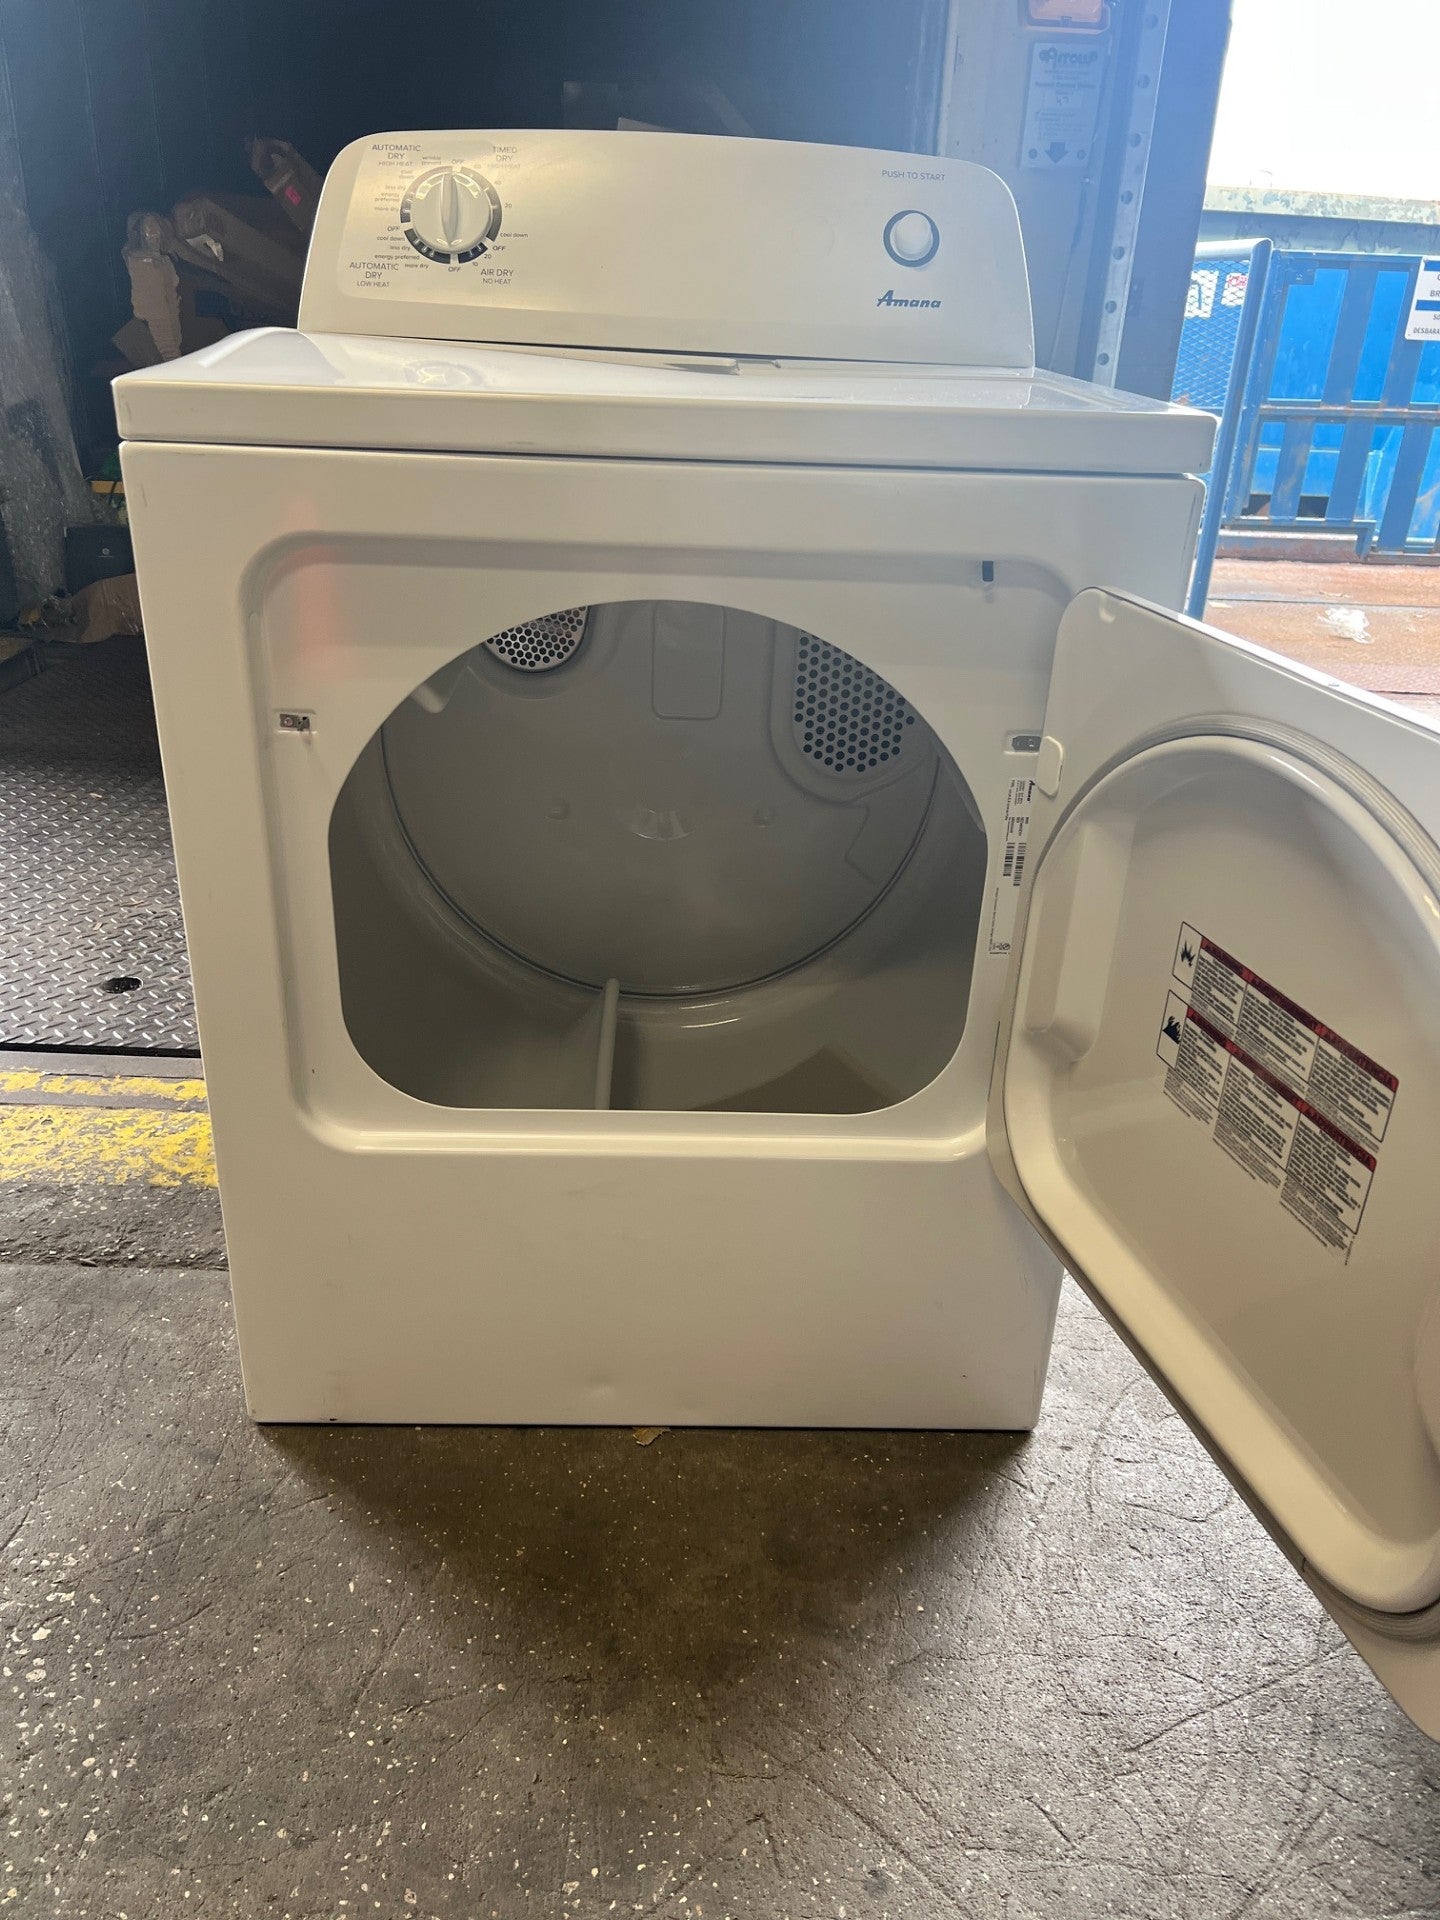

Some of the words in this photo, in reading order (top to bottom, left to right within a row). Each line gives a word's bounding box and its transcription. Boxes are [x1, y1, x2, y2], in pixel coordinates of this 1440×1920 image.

[372, 144, 421, 152] AUTOMATIC
[881, 170, 905, 178] PUSH
[907, 171, 919, 179] TO
[920, 172, 945, 181] START
[349, 261, 400, 270] AUTOMATIC
[365, 271, 382, 279] DRY
[480, 268, 495, 276] AIR
[496, 269, 514, 277] DRY
[876, 290, 942, 309] Amana
